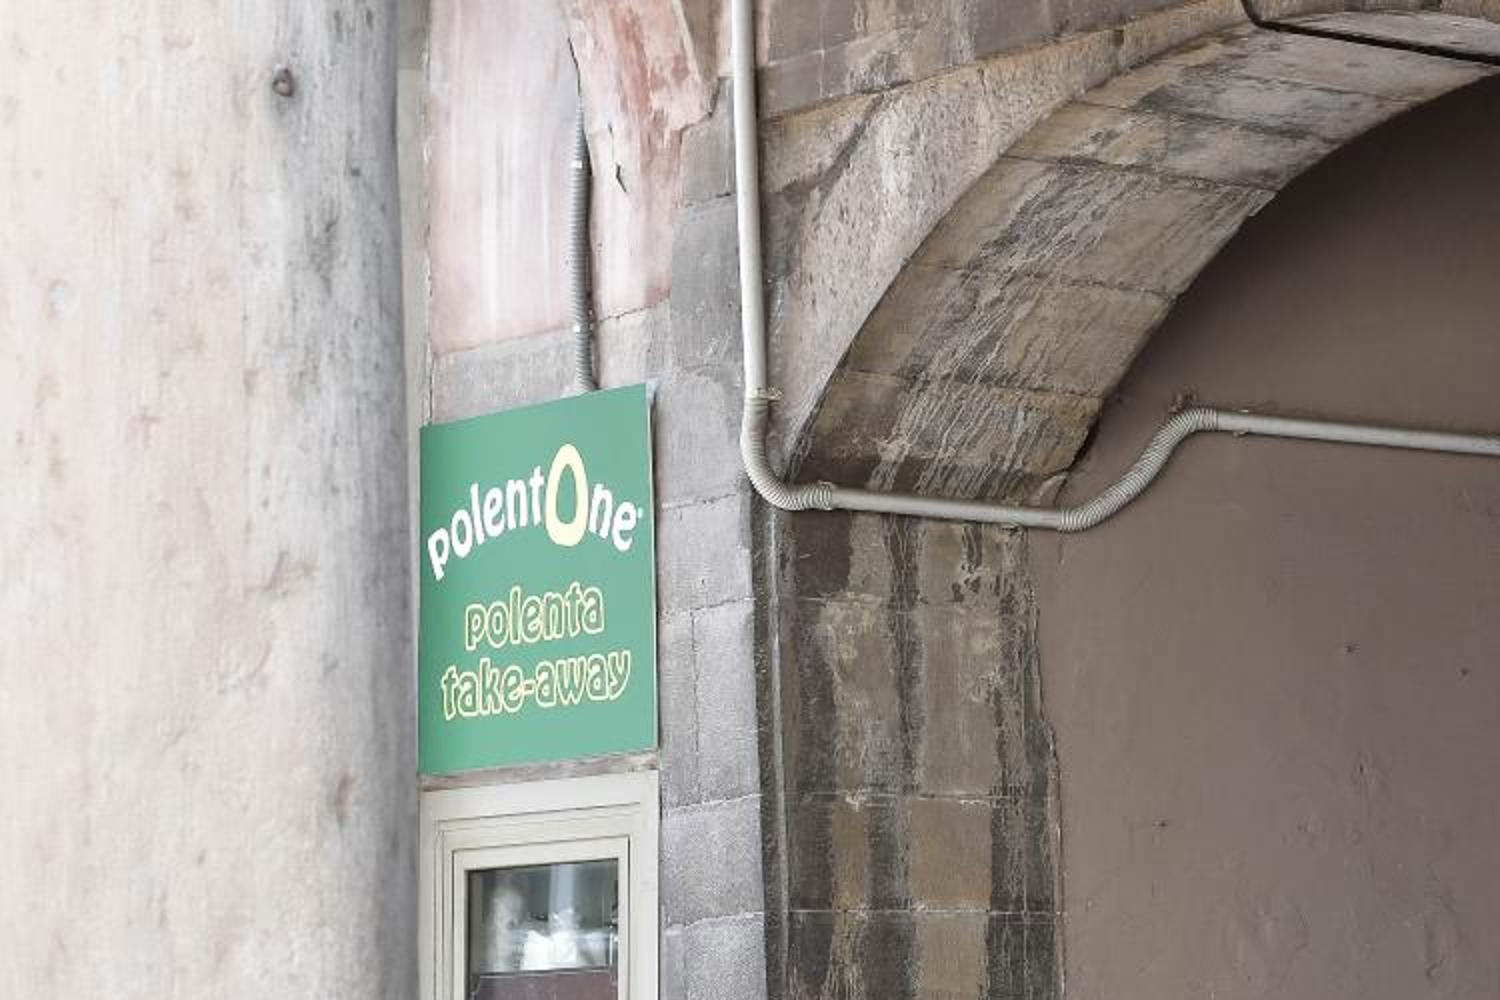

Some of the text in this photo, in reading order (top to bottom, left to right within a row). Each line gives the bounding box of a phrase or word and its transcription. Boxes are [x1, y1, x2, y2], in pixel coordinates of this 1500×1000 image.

[427, 443, 637, 580] polentOne
[466, 581, 605, 651] polenta
[442, 649, 631, 720] take-away
